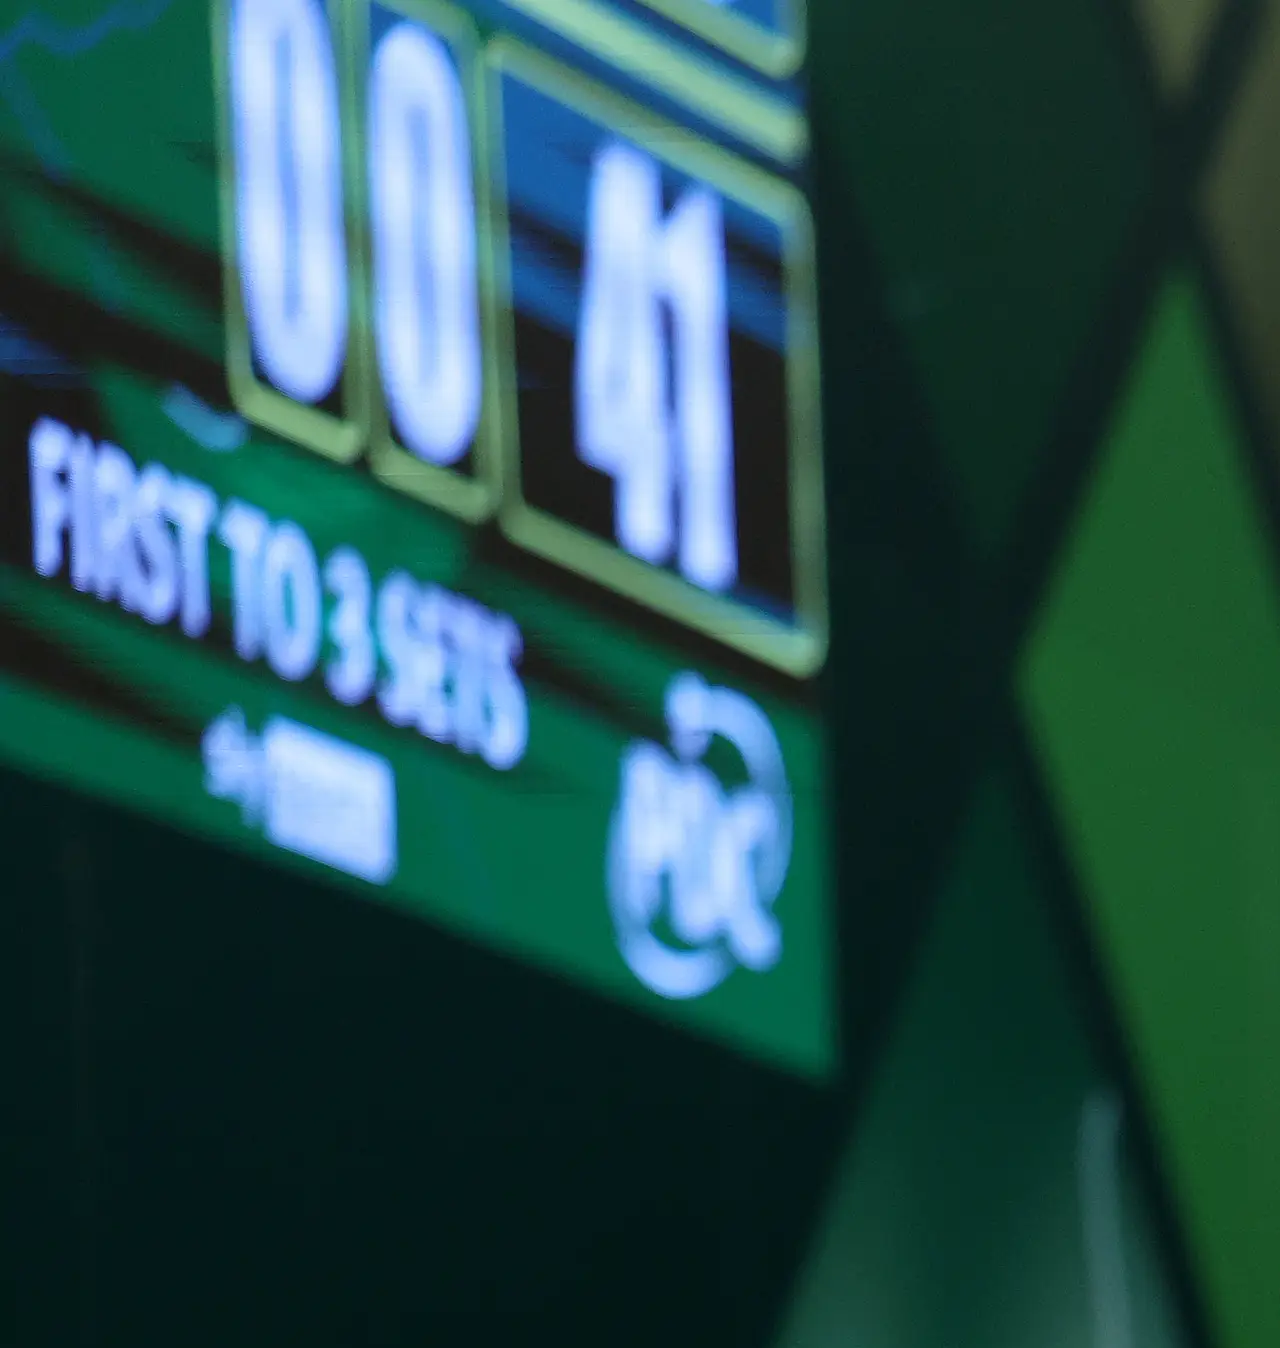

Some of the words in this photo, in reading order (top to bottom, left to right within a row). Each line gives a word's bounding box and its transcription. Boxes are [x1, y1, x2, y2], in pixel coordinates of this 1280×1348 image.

[367, 21, 482, 465] 0
[576, 142, 737, 591] 41
[29, 417, 217, 638] FIRST
[220, 497, 320, 682] TO
[324, 545, 375, 706] 3
[376, 568, 529, 771] SETS
